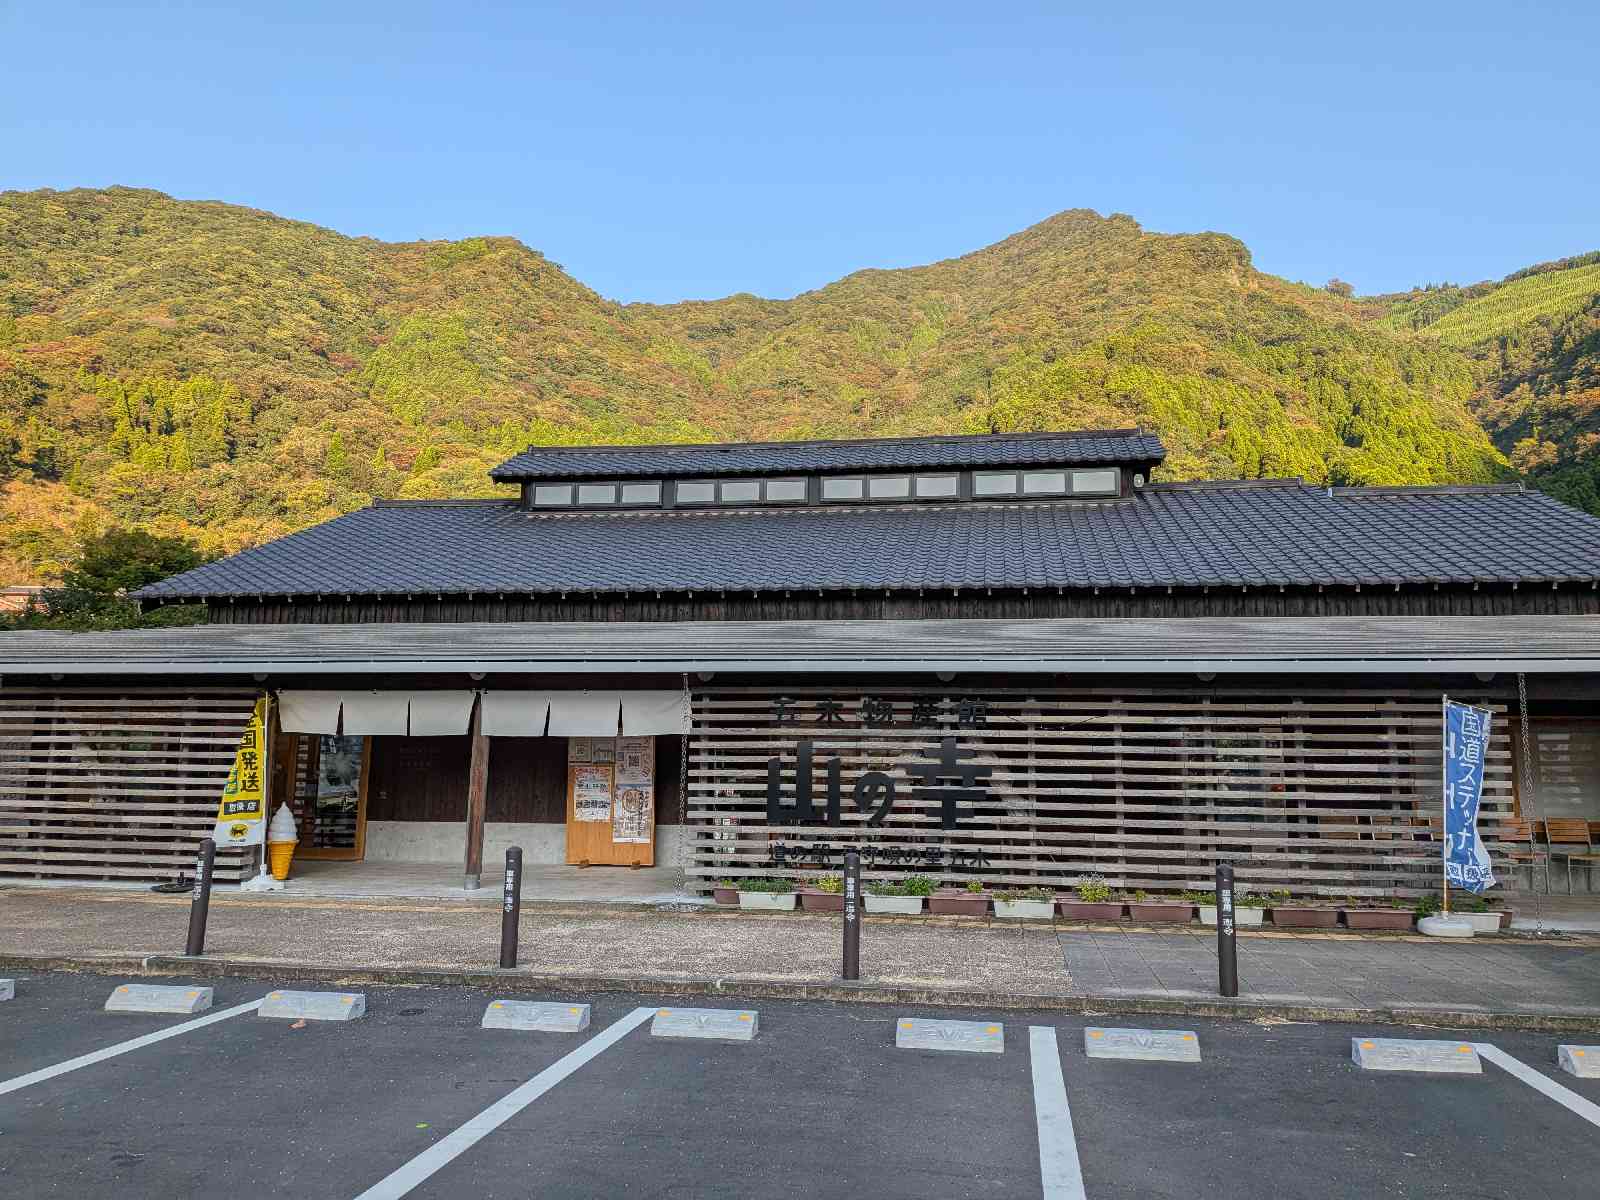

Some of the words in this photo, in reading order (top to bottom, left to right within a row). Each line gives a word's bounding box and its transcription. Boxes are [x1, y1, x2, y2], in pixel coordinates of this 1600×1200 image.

[772, 696, 987, 727] 五木物産館
[767, 737, 992, 830] 山の幸
[768, 842, 831, 865] 道の駅
